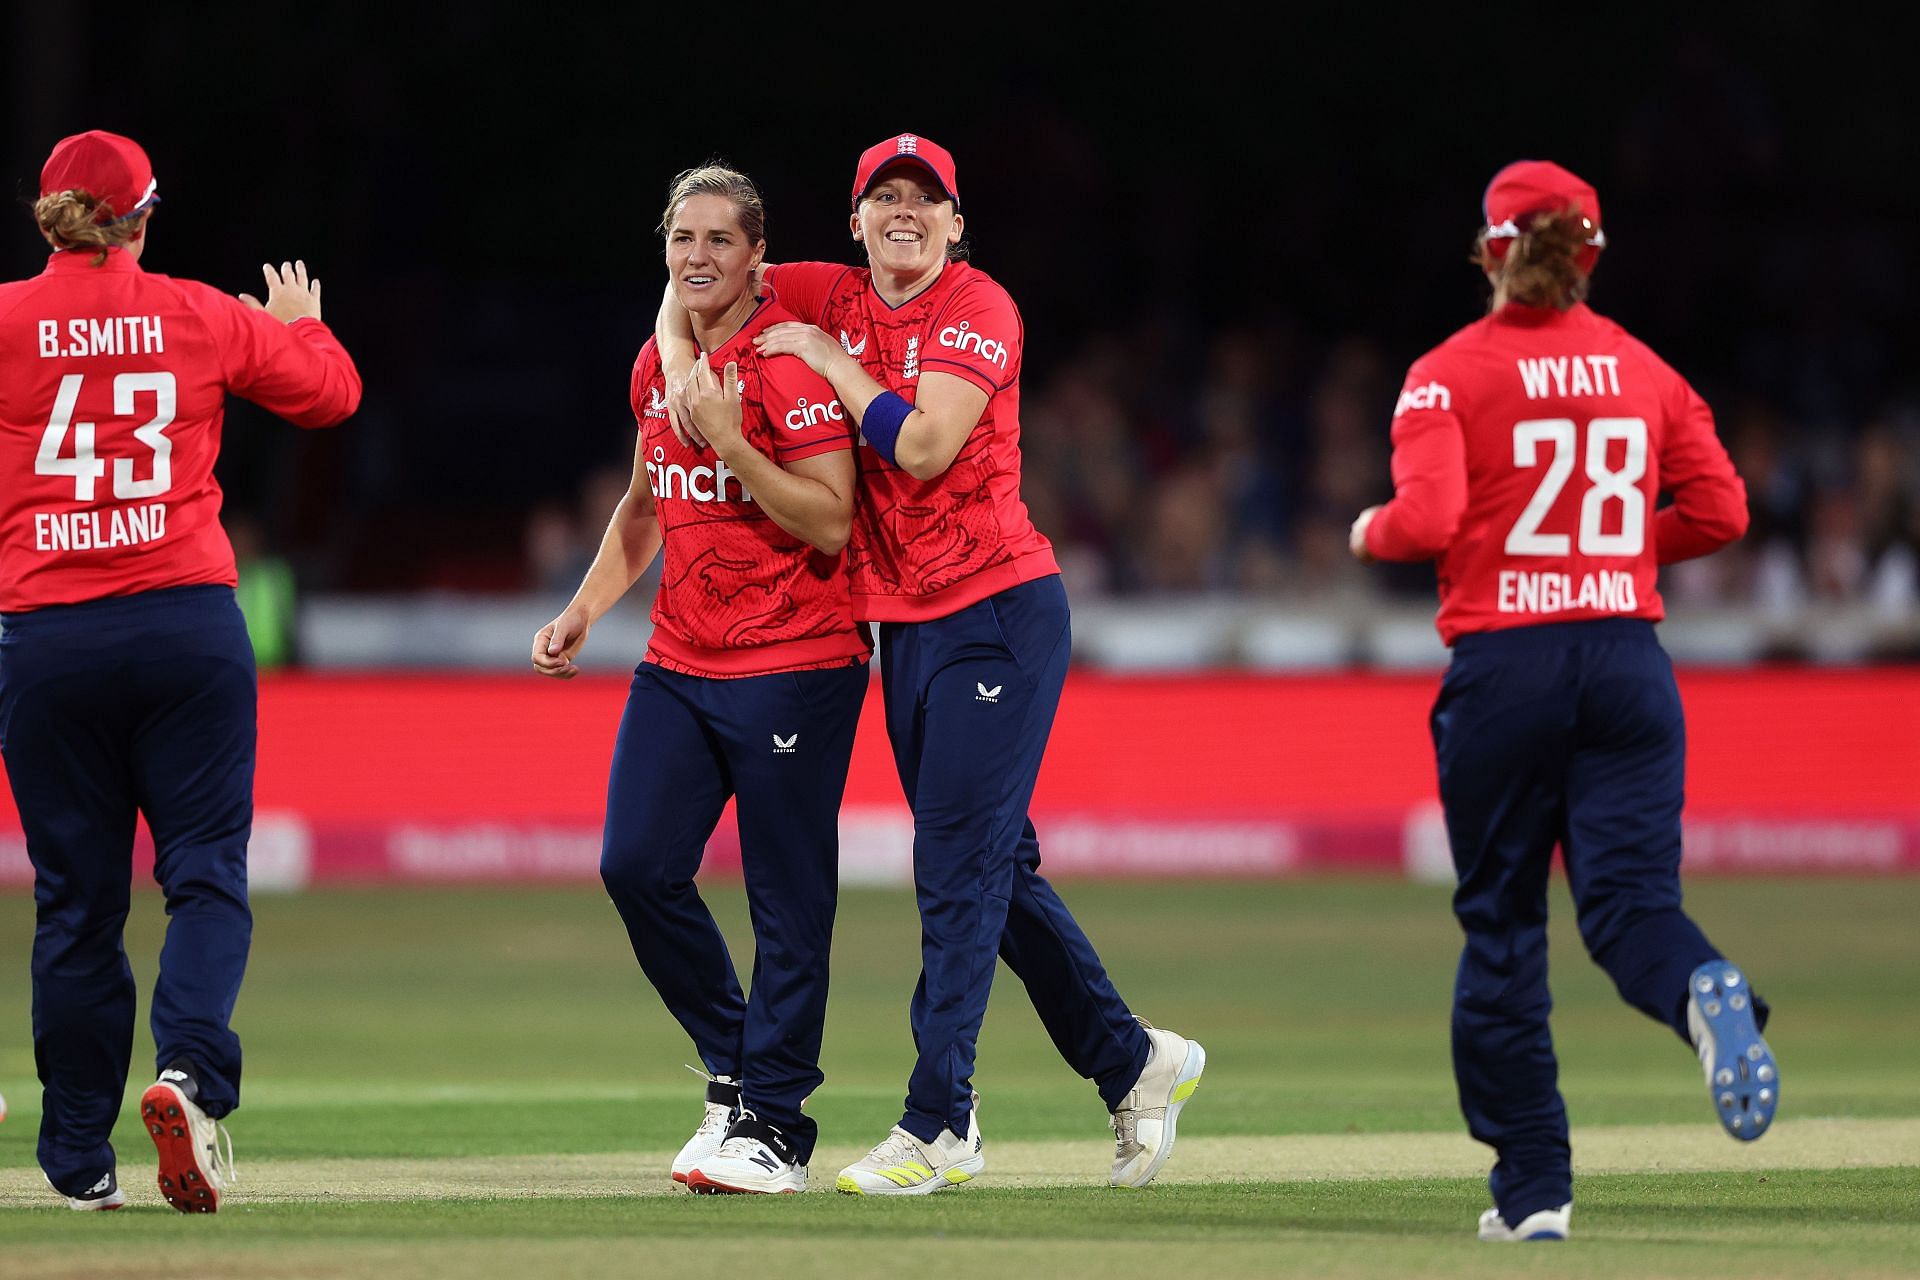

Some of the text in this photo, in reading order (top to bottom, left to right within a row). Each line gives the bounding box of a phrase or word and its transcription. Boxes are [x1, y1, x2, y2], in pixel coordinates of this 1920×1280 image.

[38, 315, 164, 358] B.SMITH
[939, 320, 1008, 370] cinch
[1517, 354, 1621, 400] WYATT
[34, 371, 177, 501] 43
[785, 397, 844, 430] cinc
[1505, 417, 1648, 557] 28
[34, 503, 166, 551] ENGLAND
[1497, 569, 1638, 614] ENGLAND
